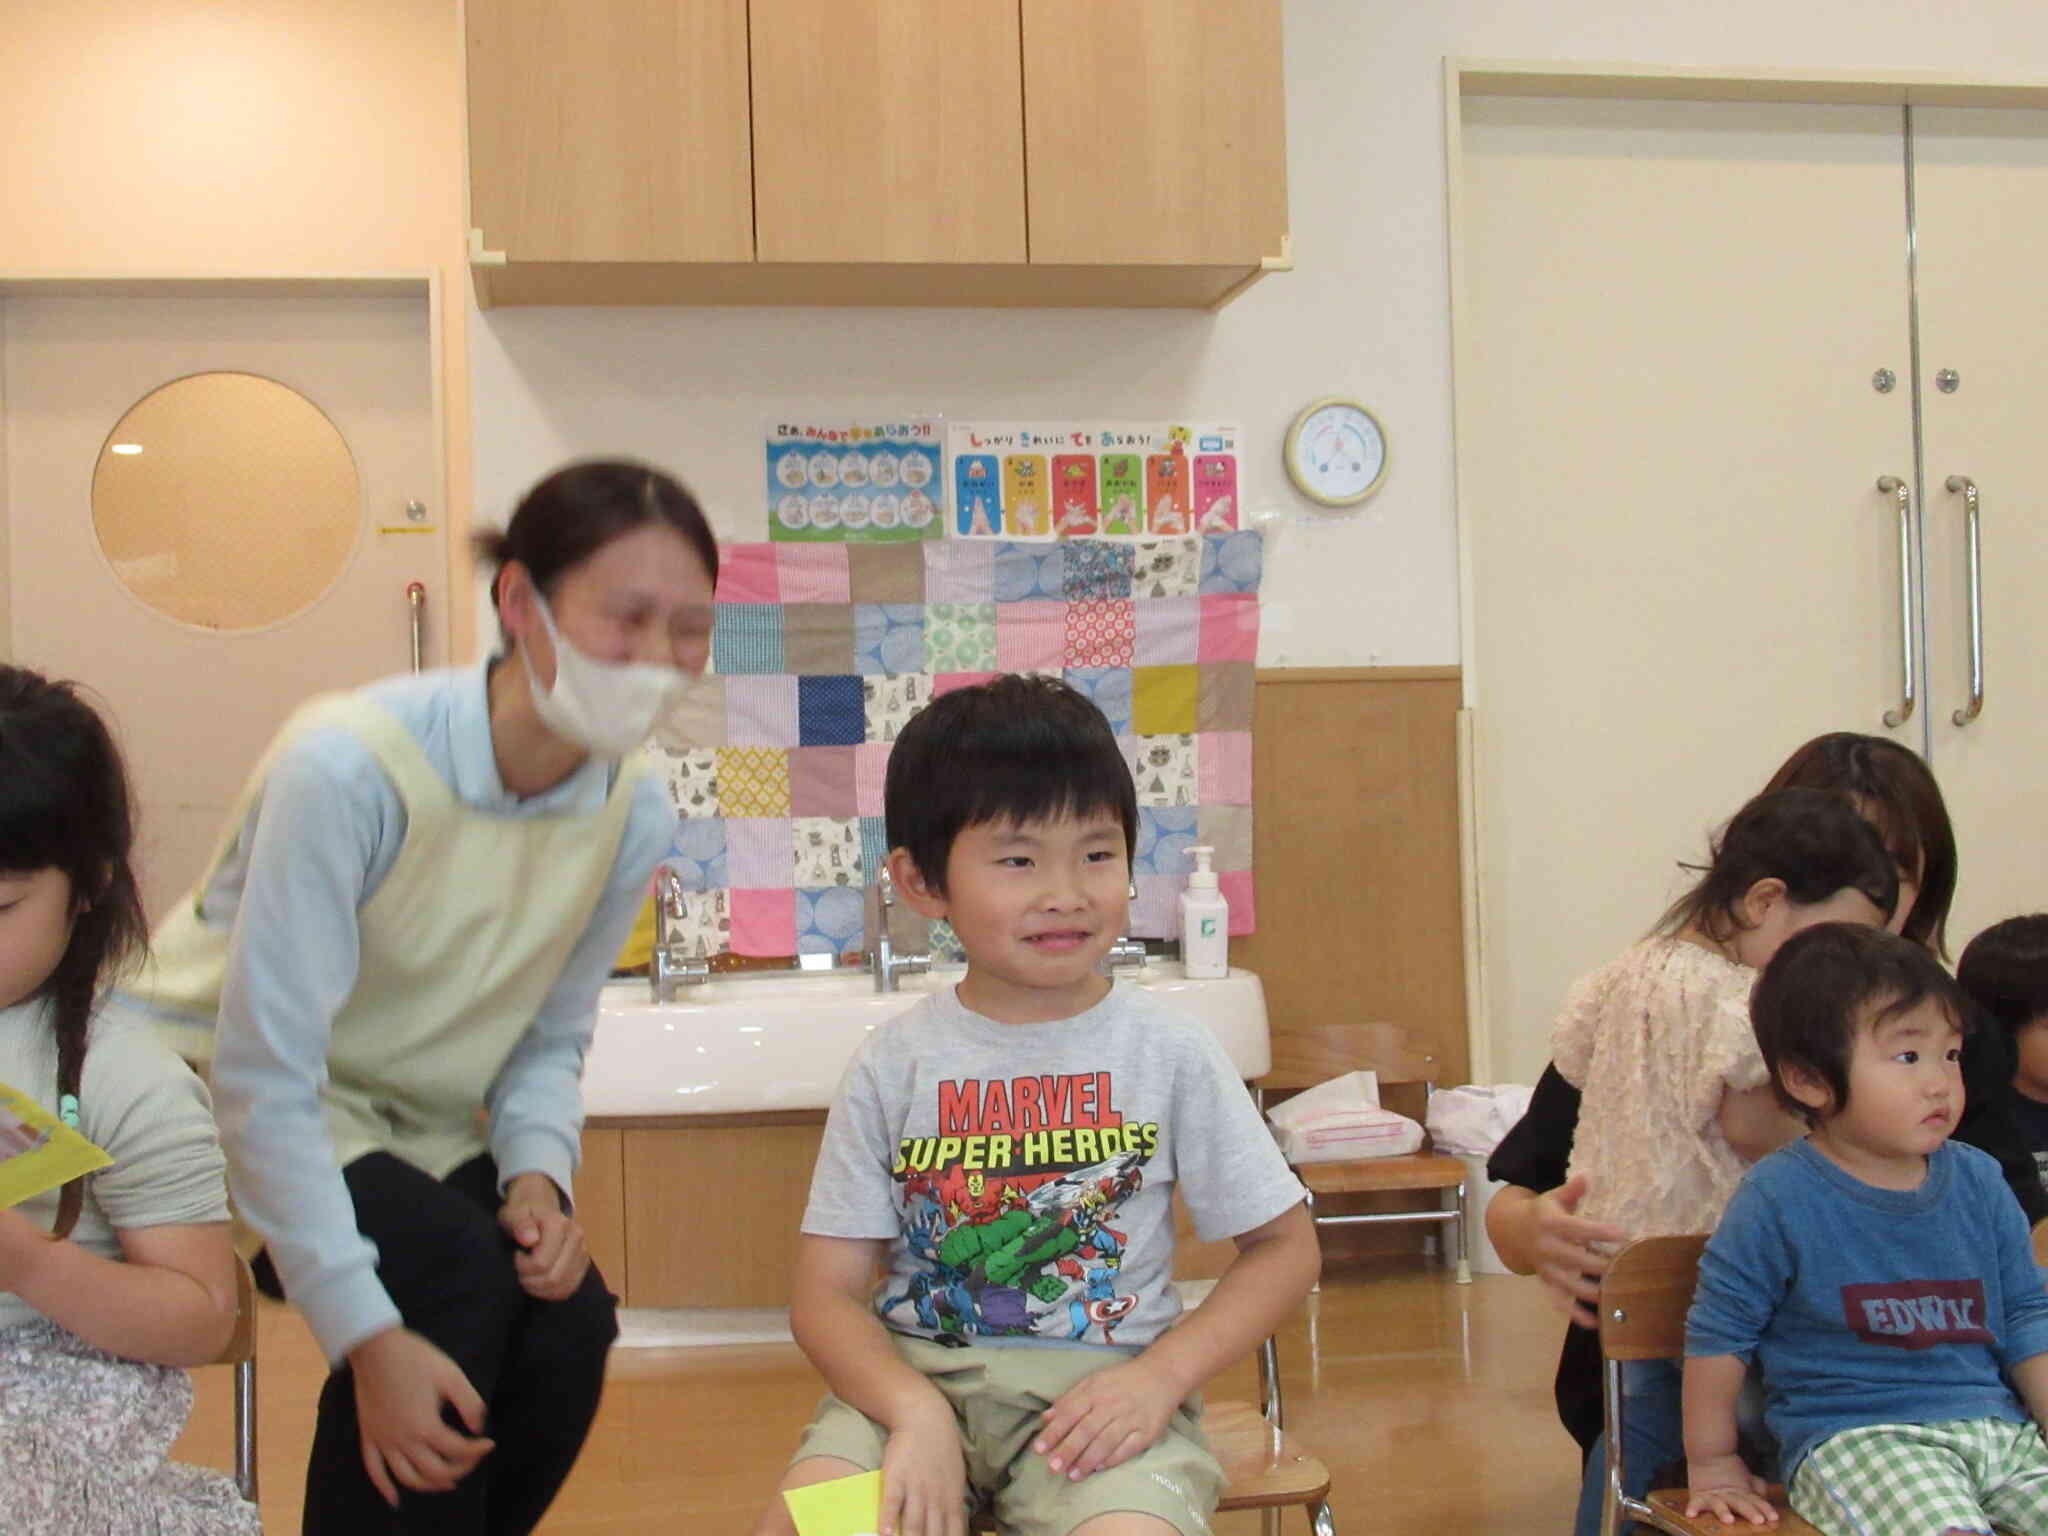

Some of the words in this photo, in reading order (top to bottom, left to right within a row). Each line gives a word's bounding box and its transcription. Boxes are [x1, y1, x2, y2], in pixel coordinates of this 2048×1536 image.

[938, 1072, 1122, 1136] MARVEL
[893, 1134, 1013, 1173] SUPER
[1024, 1121, 1160, 1166] HEROES
